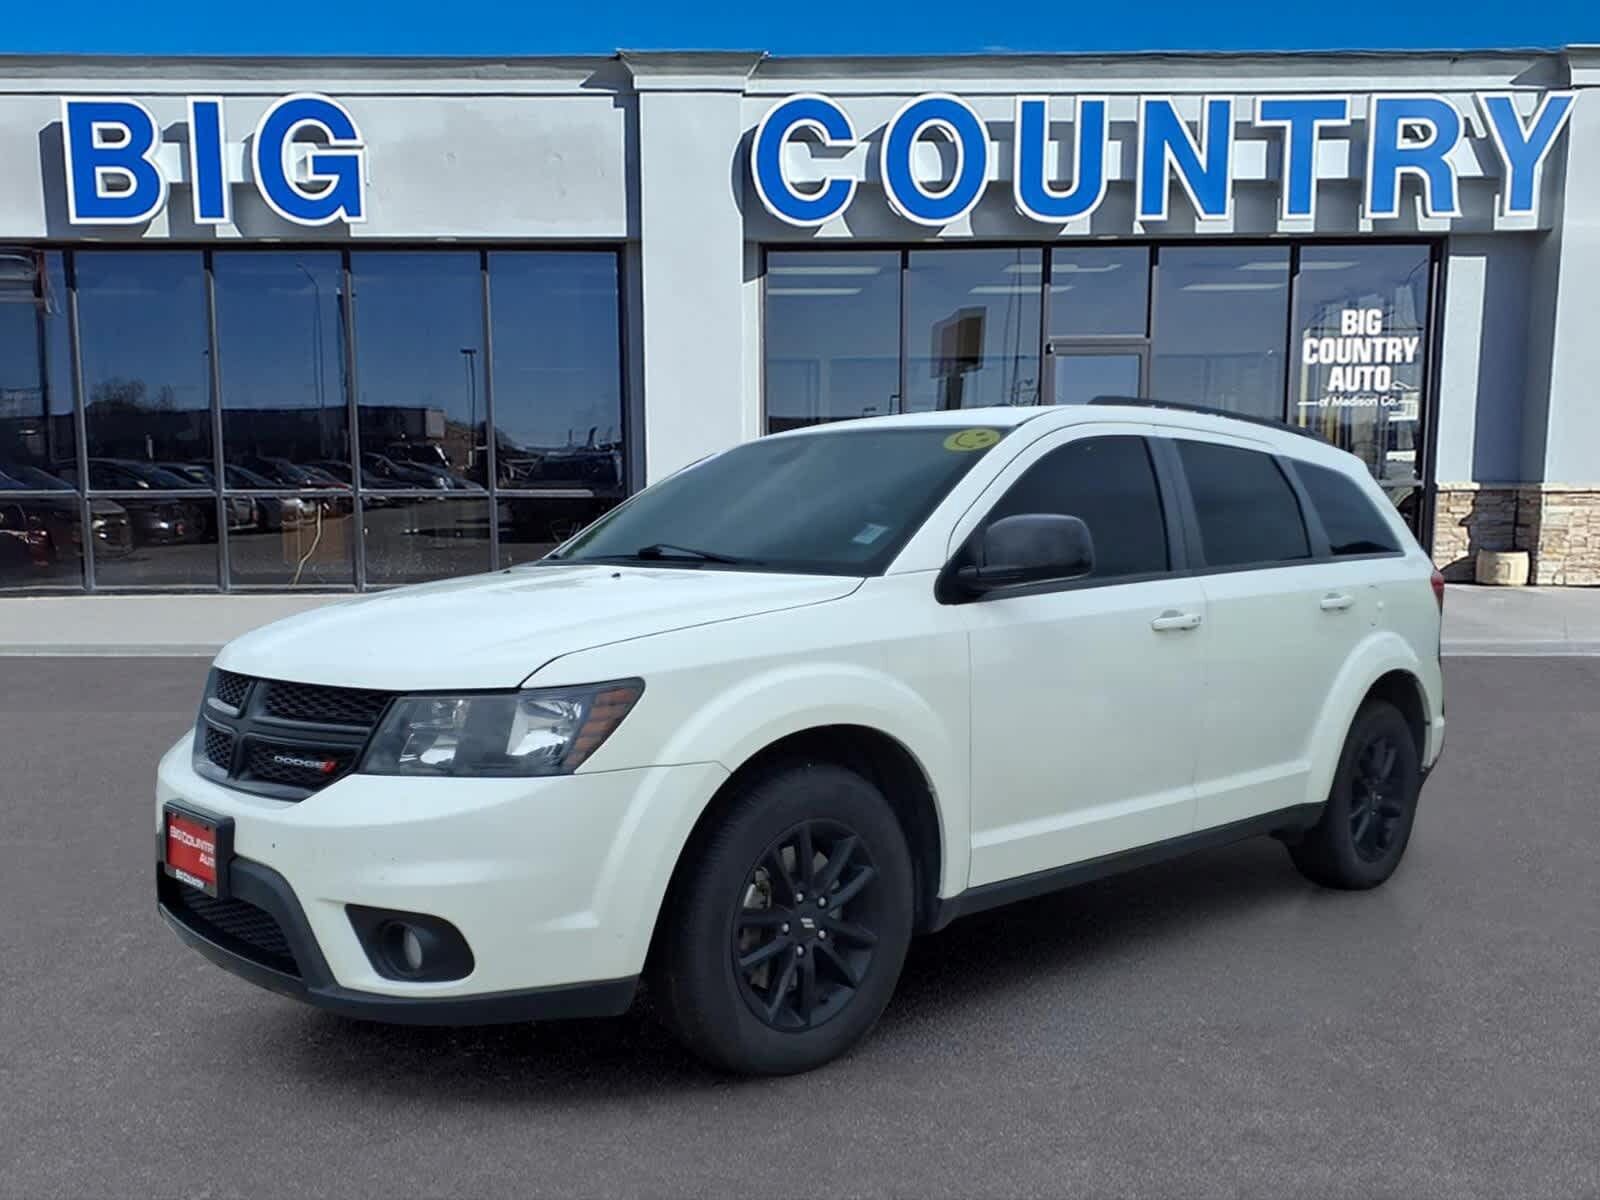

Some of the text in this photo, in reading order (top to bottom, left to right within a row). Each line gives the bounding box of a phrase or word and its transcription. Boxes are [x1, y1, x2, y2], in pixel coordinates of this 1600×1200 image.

[60, 90, 1577, 228] BIG COUNTRY
[1341, 308, 1382, 336] BIG
[1303, 336, 1419, 364] COUNTRY
[1327, 365, 1392, 392] AUTO
[1319, 396, 1330, 407] of
[1331, 395, 1378, 408] Madison
[273, 755, 328, 769] DODGE
